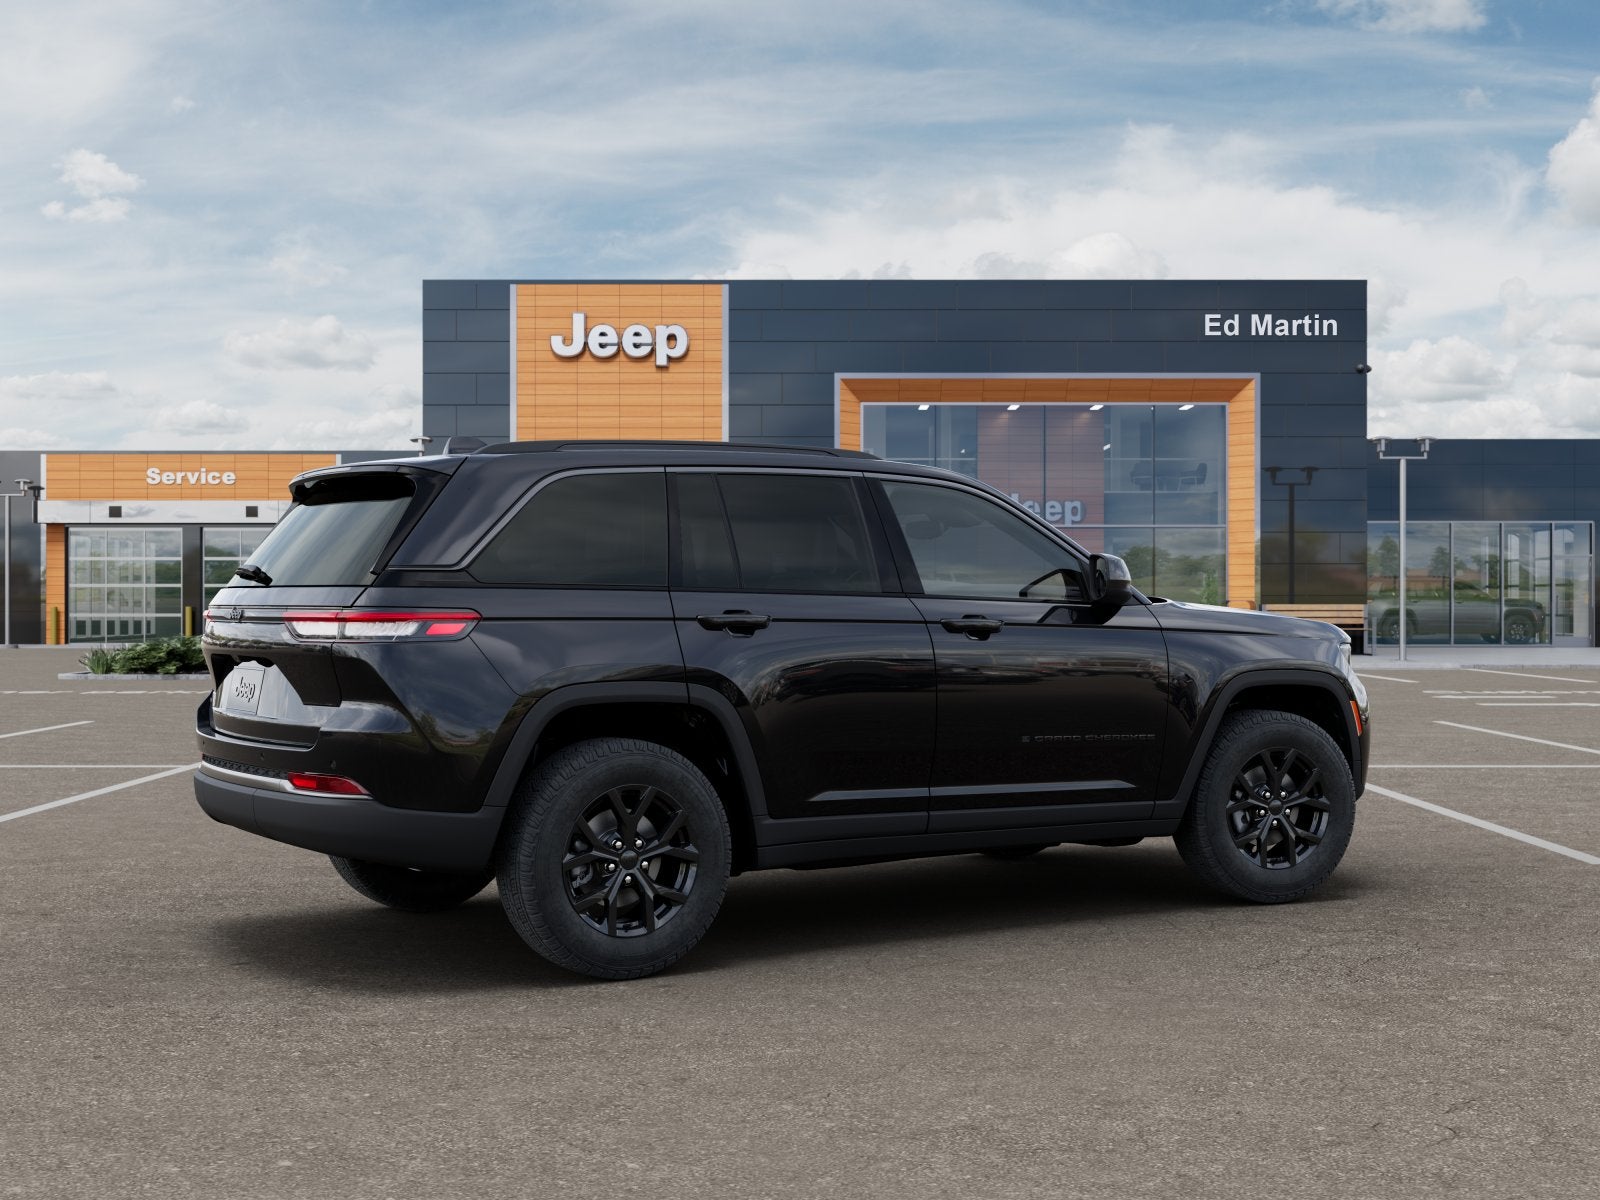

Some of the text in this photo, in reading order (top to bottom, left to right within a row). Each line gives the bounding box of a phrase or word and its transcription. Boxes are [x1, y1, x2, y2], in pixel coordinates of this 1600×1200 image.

[550, 311, 689, 368] Jeep
[1204, 313, 1338, 337] Ed Martin
[145, 466, 237, 486] Service
[1010, 492, 1086, 528] eep
